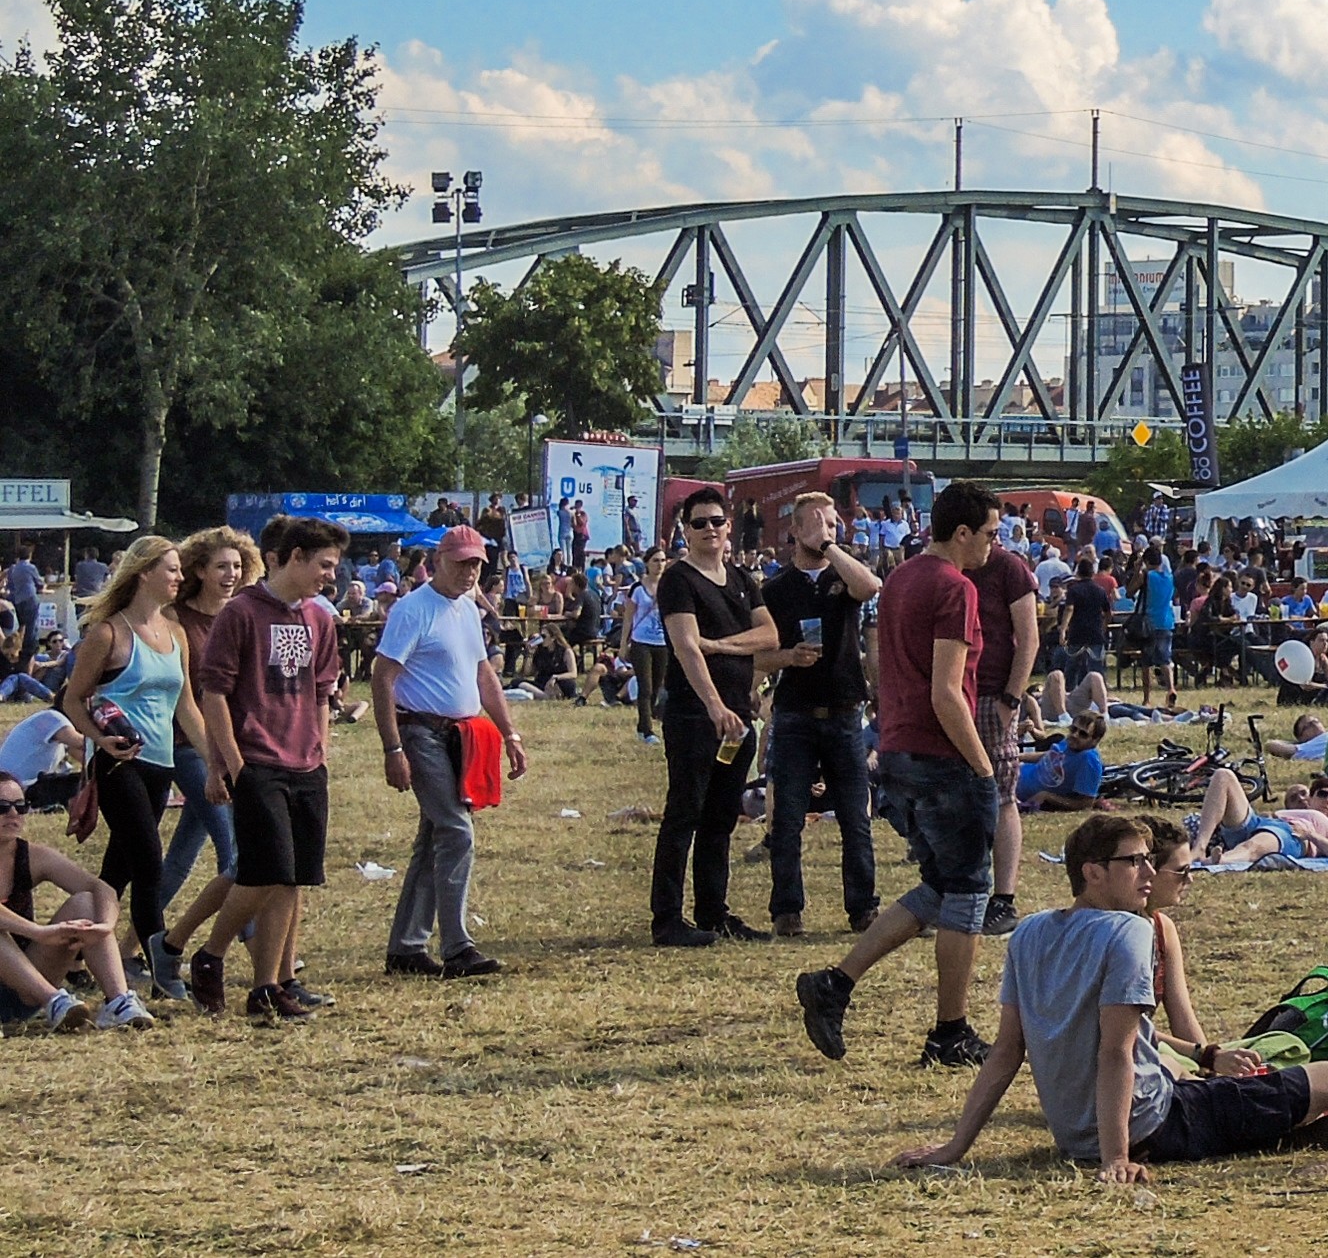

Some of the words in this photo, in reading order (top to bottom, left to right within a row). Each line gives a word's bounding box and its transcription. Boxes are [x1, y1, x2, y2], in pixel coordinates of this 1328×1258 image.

[1182, 370, 1208, 453] COFFEE
[2, 485, 58, 502] FFEL
[578, 482, 592, 494] U6
